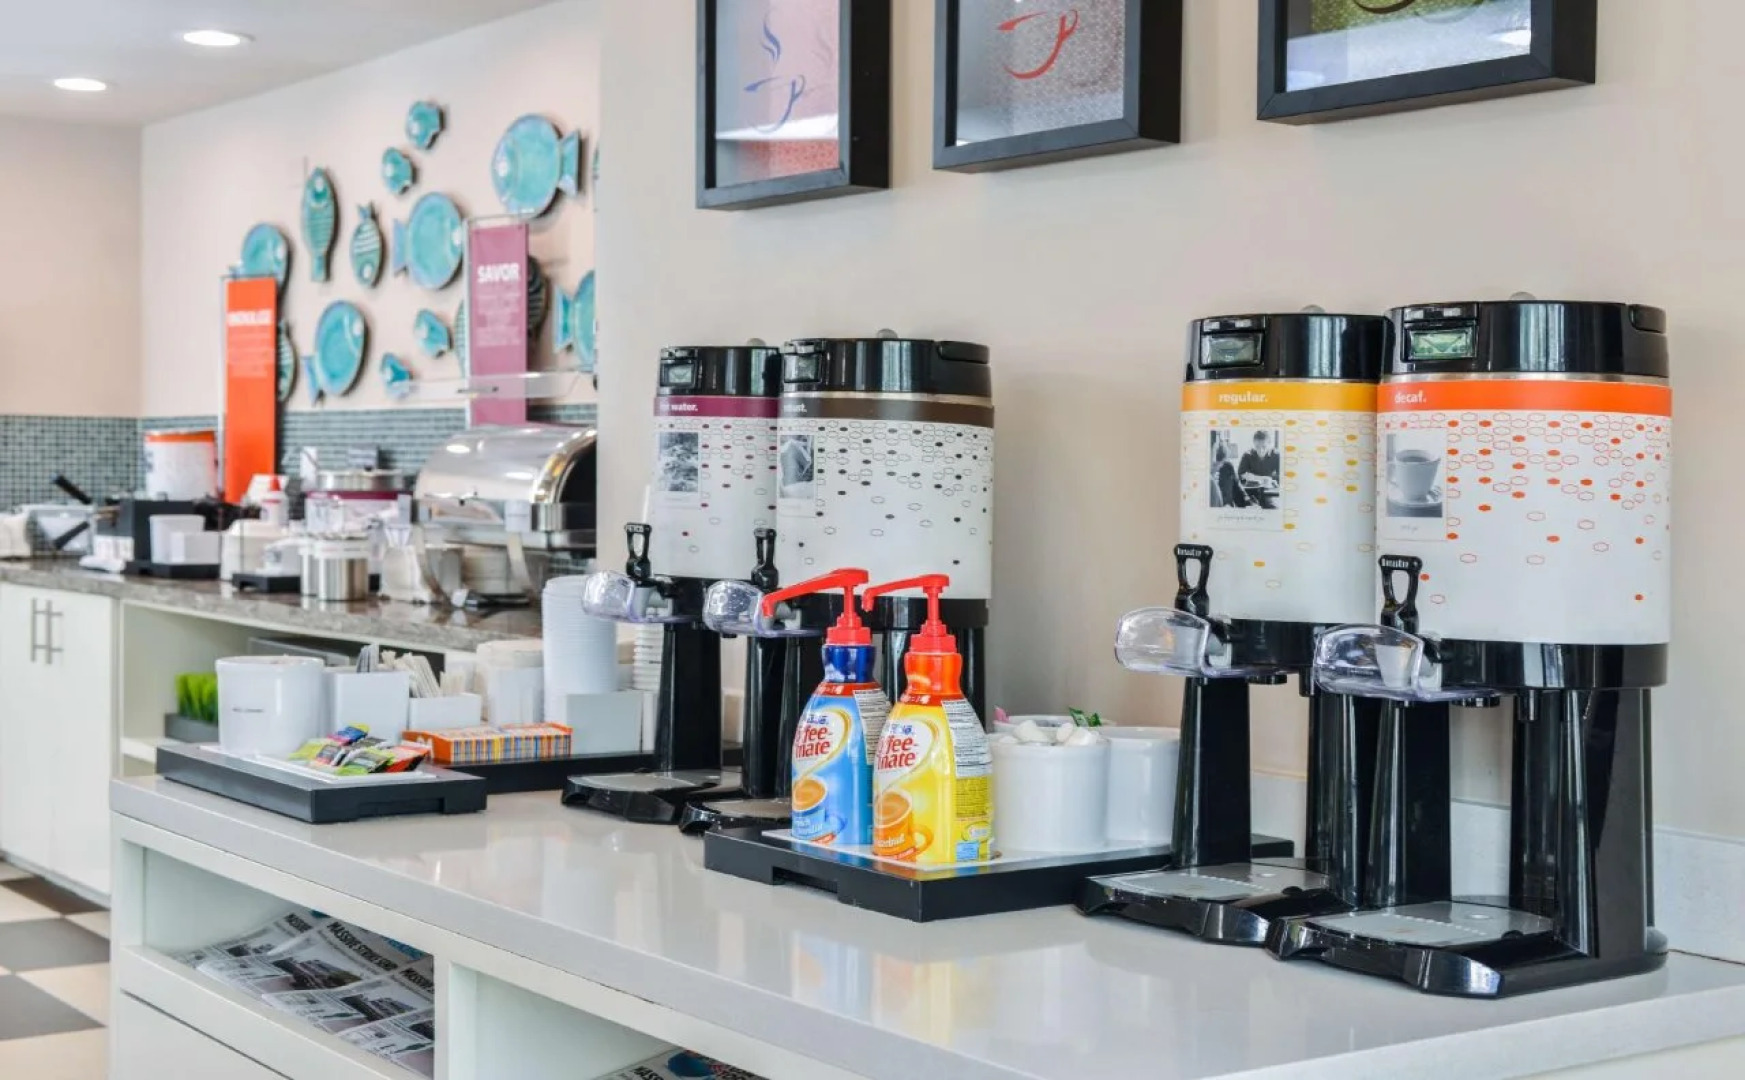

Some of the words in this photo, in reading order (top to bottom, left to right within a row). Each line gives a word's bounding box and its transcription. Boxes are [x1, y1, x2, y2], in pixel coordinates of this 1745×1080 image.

[477, 262, 519, 283] SAVOR
[1219, 391, 1268, 404] regular.
[1393, 390, 1427, 403] decaf.
